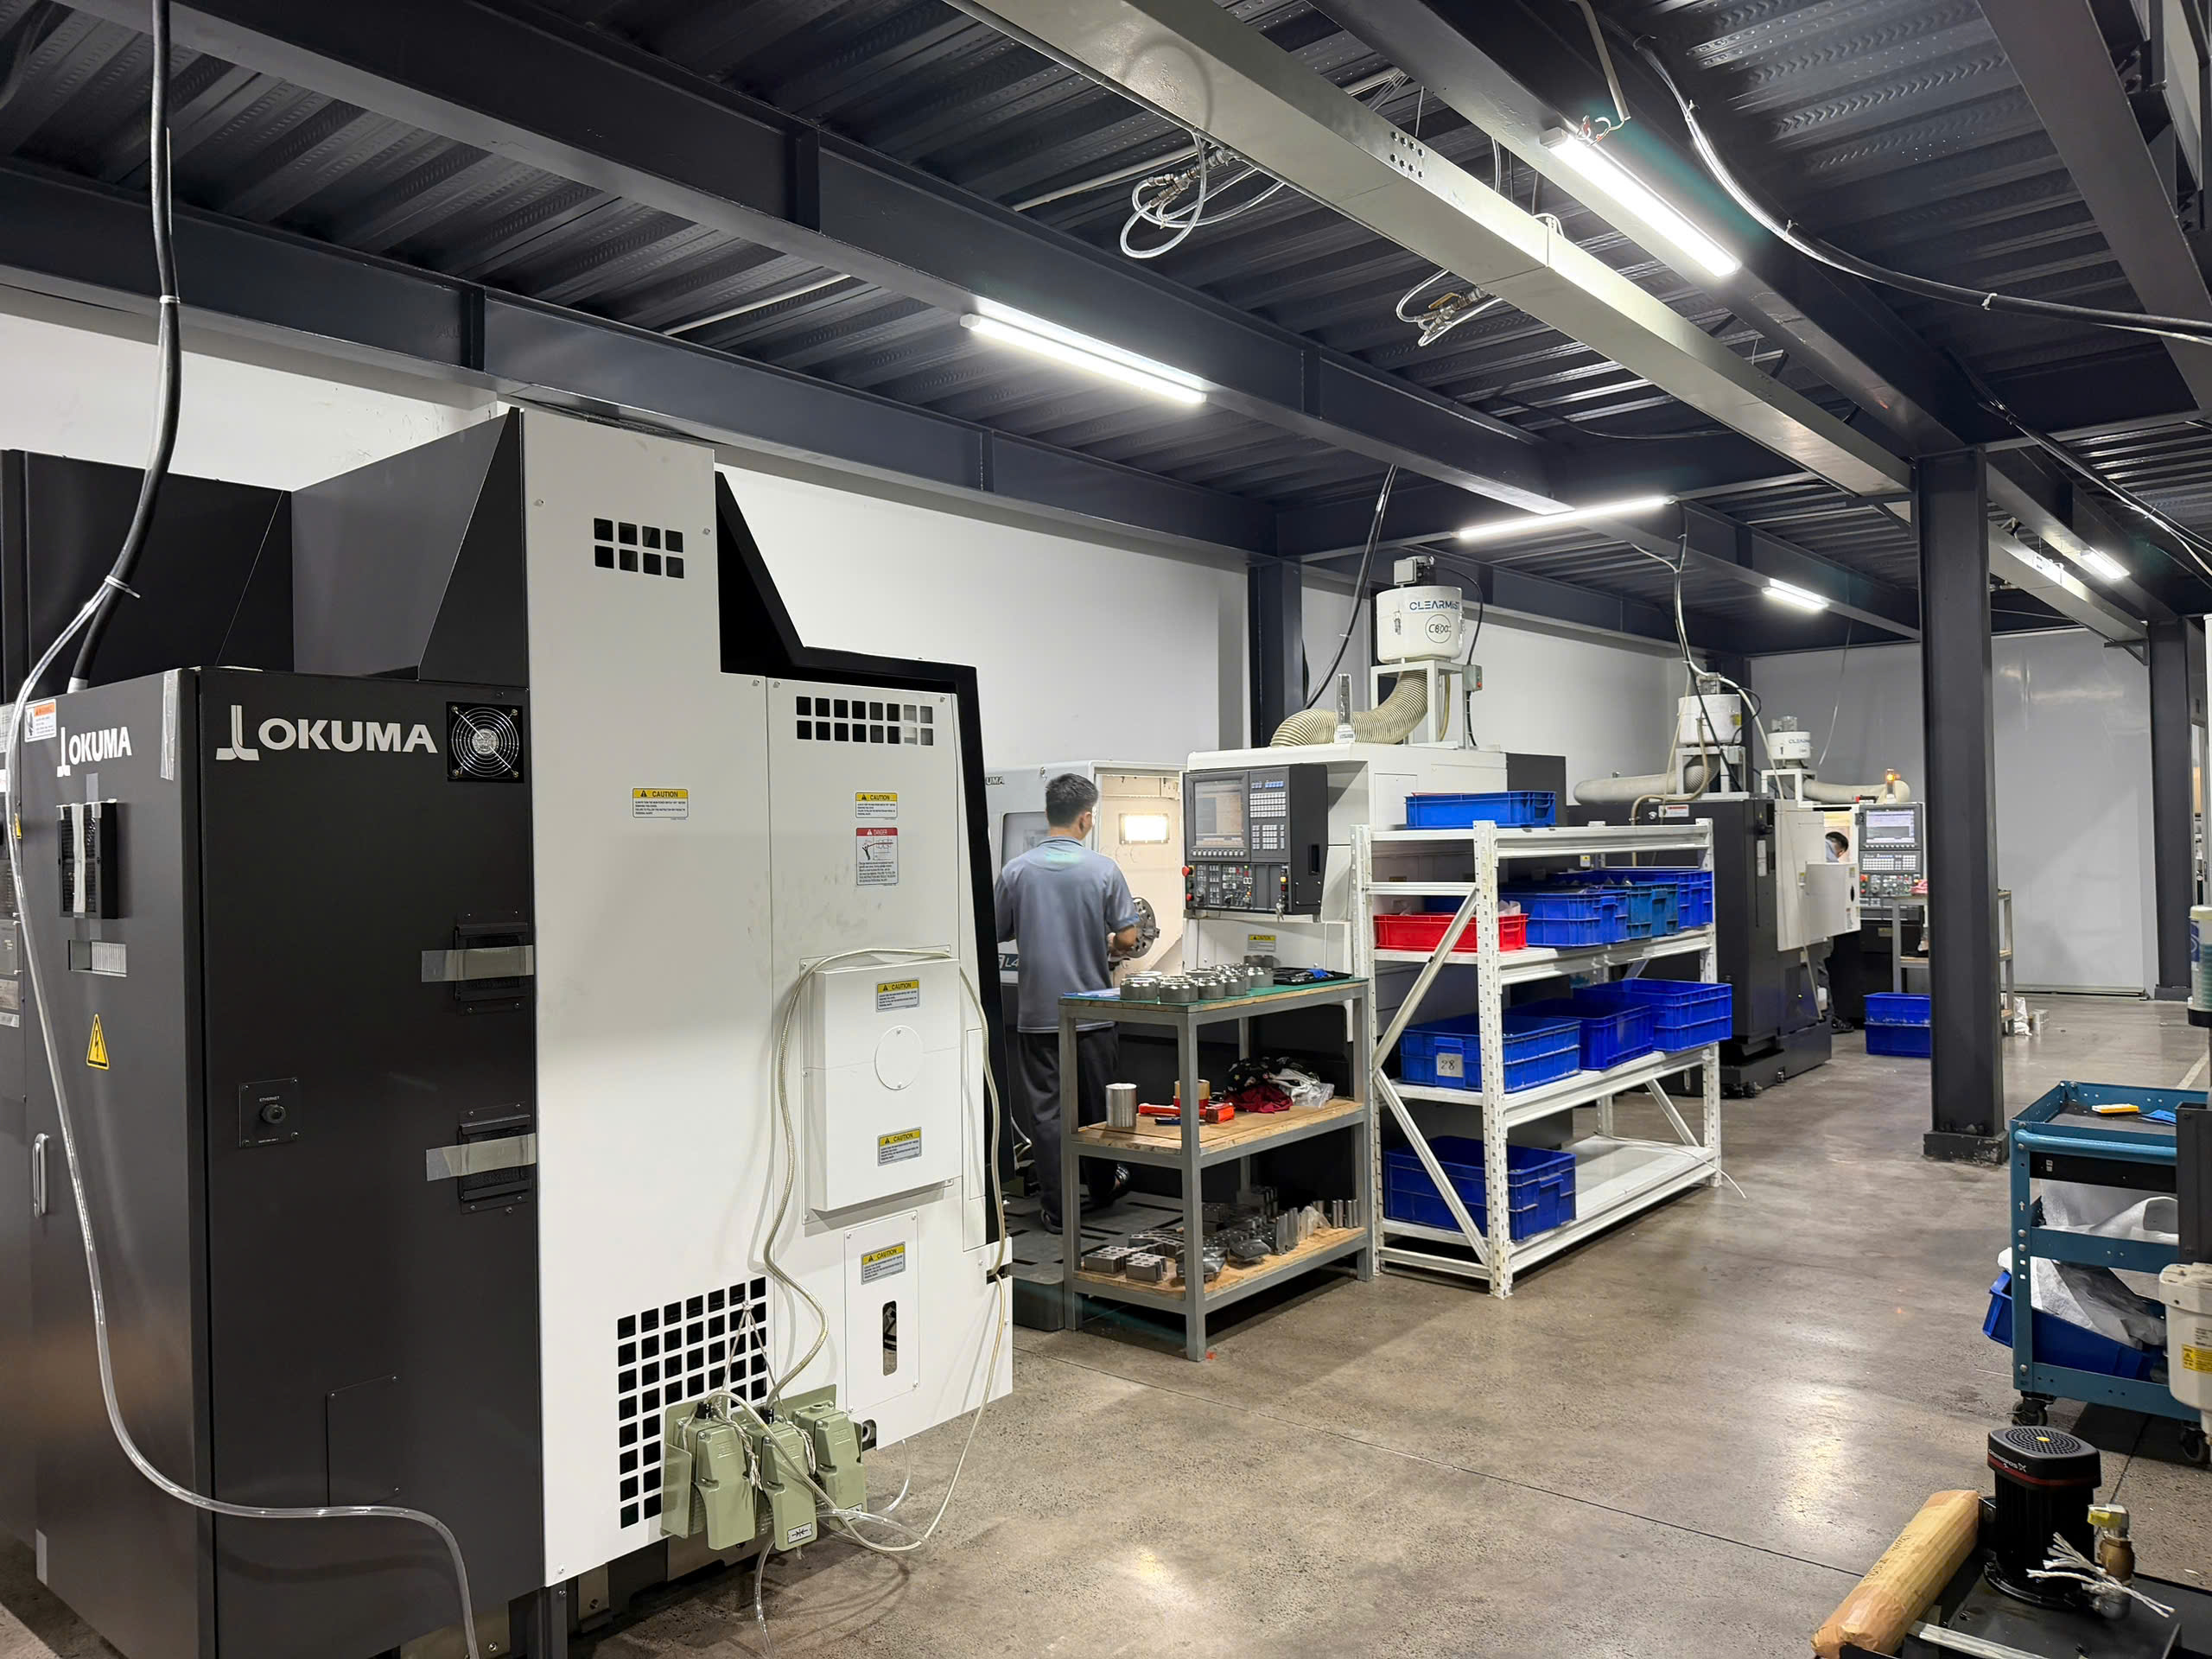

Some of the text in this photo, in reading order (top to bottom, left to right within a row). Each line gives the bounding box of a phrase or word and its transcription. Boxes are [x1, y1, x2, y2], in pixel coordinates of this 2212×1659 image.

[257, 717, 438, 753] OKUMA
[68, 726, 132, 765] OKUMA
[986, 776, 1005, 785] UMA
[1441, 1058, 1455, 1071] 28
[893, 1133, 913, 1142] CAUTION
[876, 1248, 898, 1260] CAUTION
